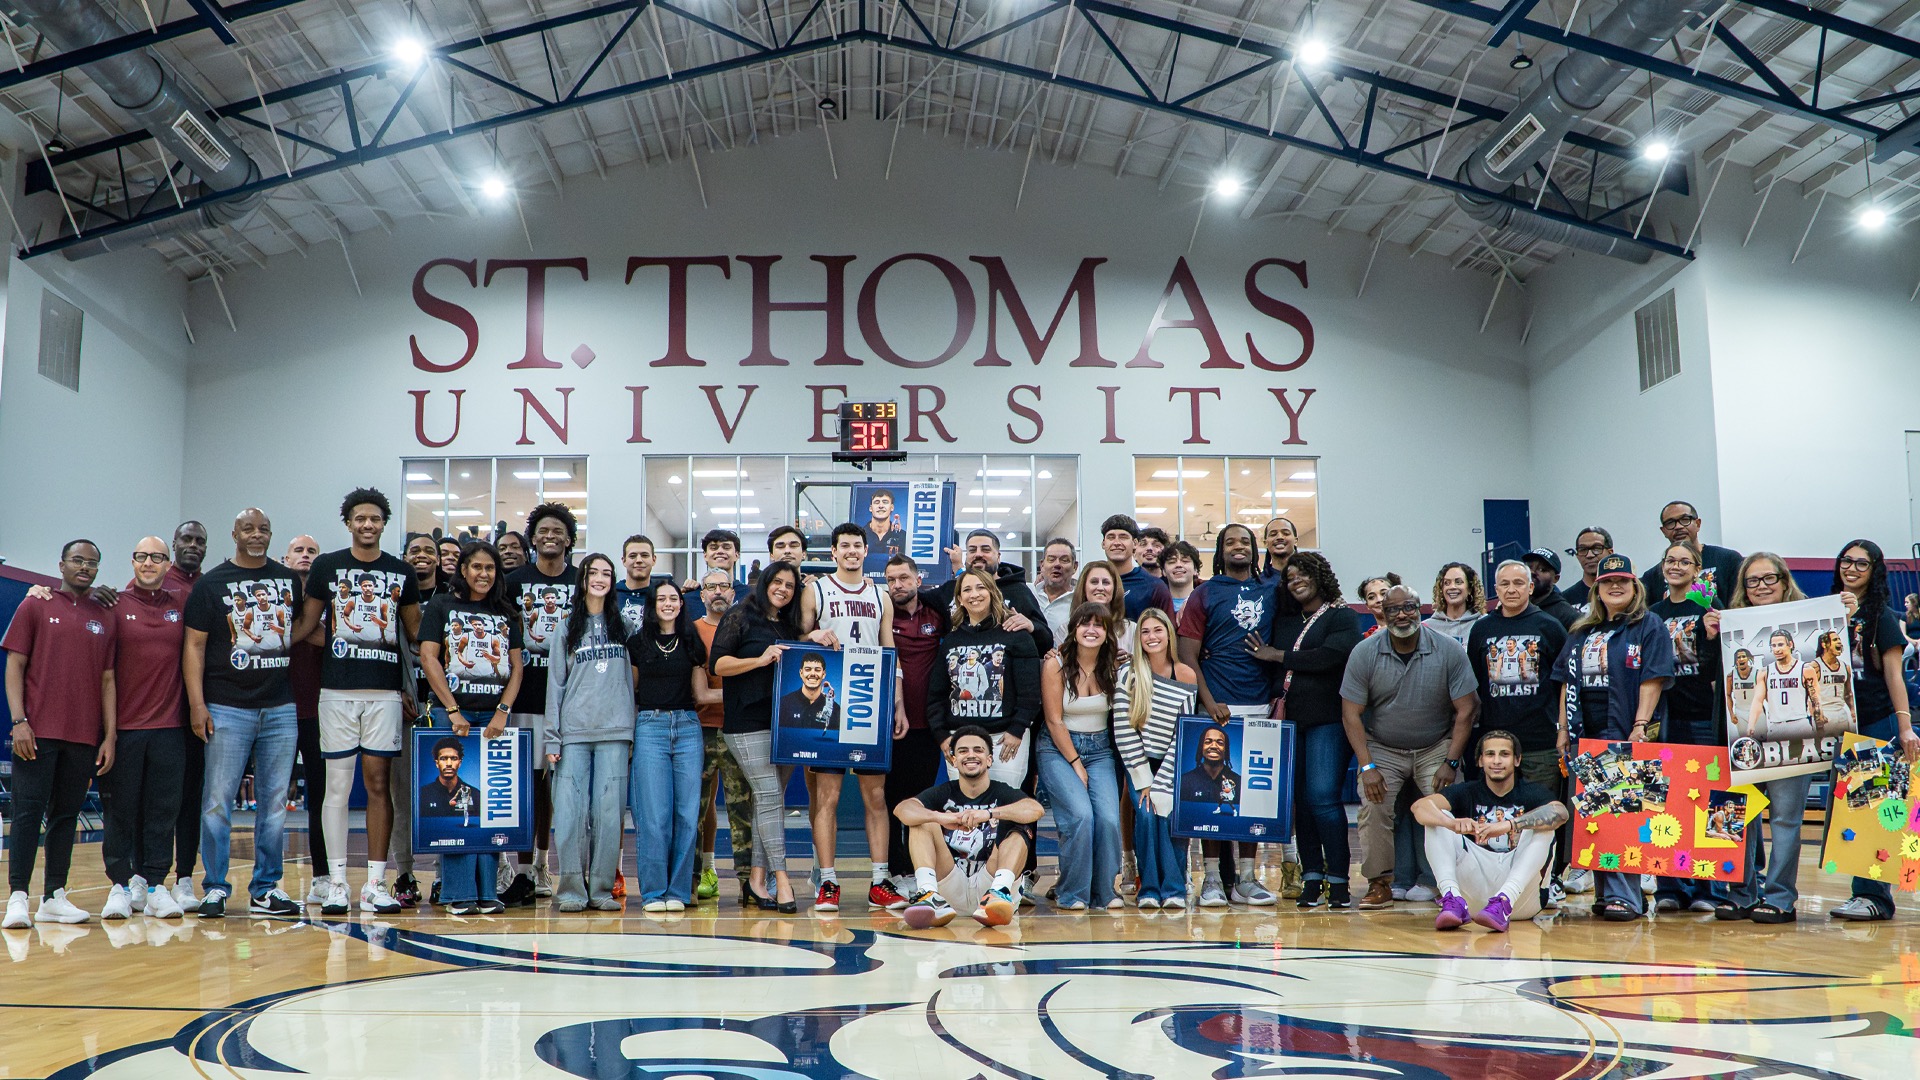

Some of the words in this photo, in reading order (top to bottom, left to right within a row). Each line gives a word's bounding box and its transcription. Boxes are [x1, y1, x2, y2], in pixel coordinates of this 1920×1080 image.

[409, 257, 596, 373] ST.
[626, 253, 1315, 372] THOMAS
[408, 386, 1317, 447] UNIVERSITY
[851, 422, 888, 449] 30
[911, 490, 937, 559] NUTTER
[829, 601, 843, 619] ST.
[844, 600, 877, 619] THOMAS
[850, 621, 861, 643] 4
[347, 644, 398, 664] THROWER
[1499, 684, 1539, 697] BLAST
[1770, 678, 1778, 689] ST.
[1779, 677, 1799, 689] THOMAS
[847, 663, 877, 731] TOVAR
[1781, 691, 1789, 705] 0
[959, 699, 1003, 717] CRUZ
[1762, 737, 1843, 768] BLAS
[487, 739, 513, 822] THROWER
[1884, 805, 1904, 822] 4K
[1654, 824, 1674, 836] 4K
